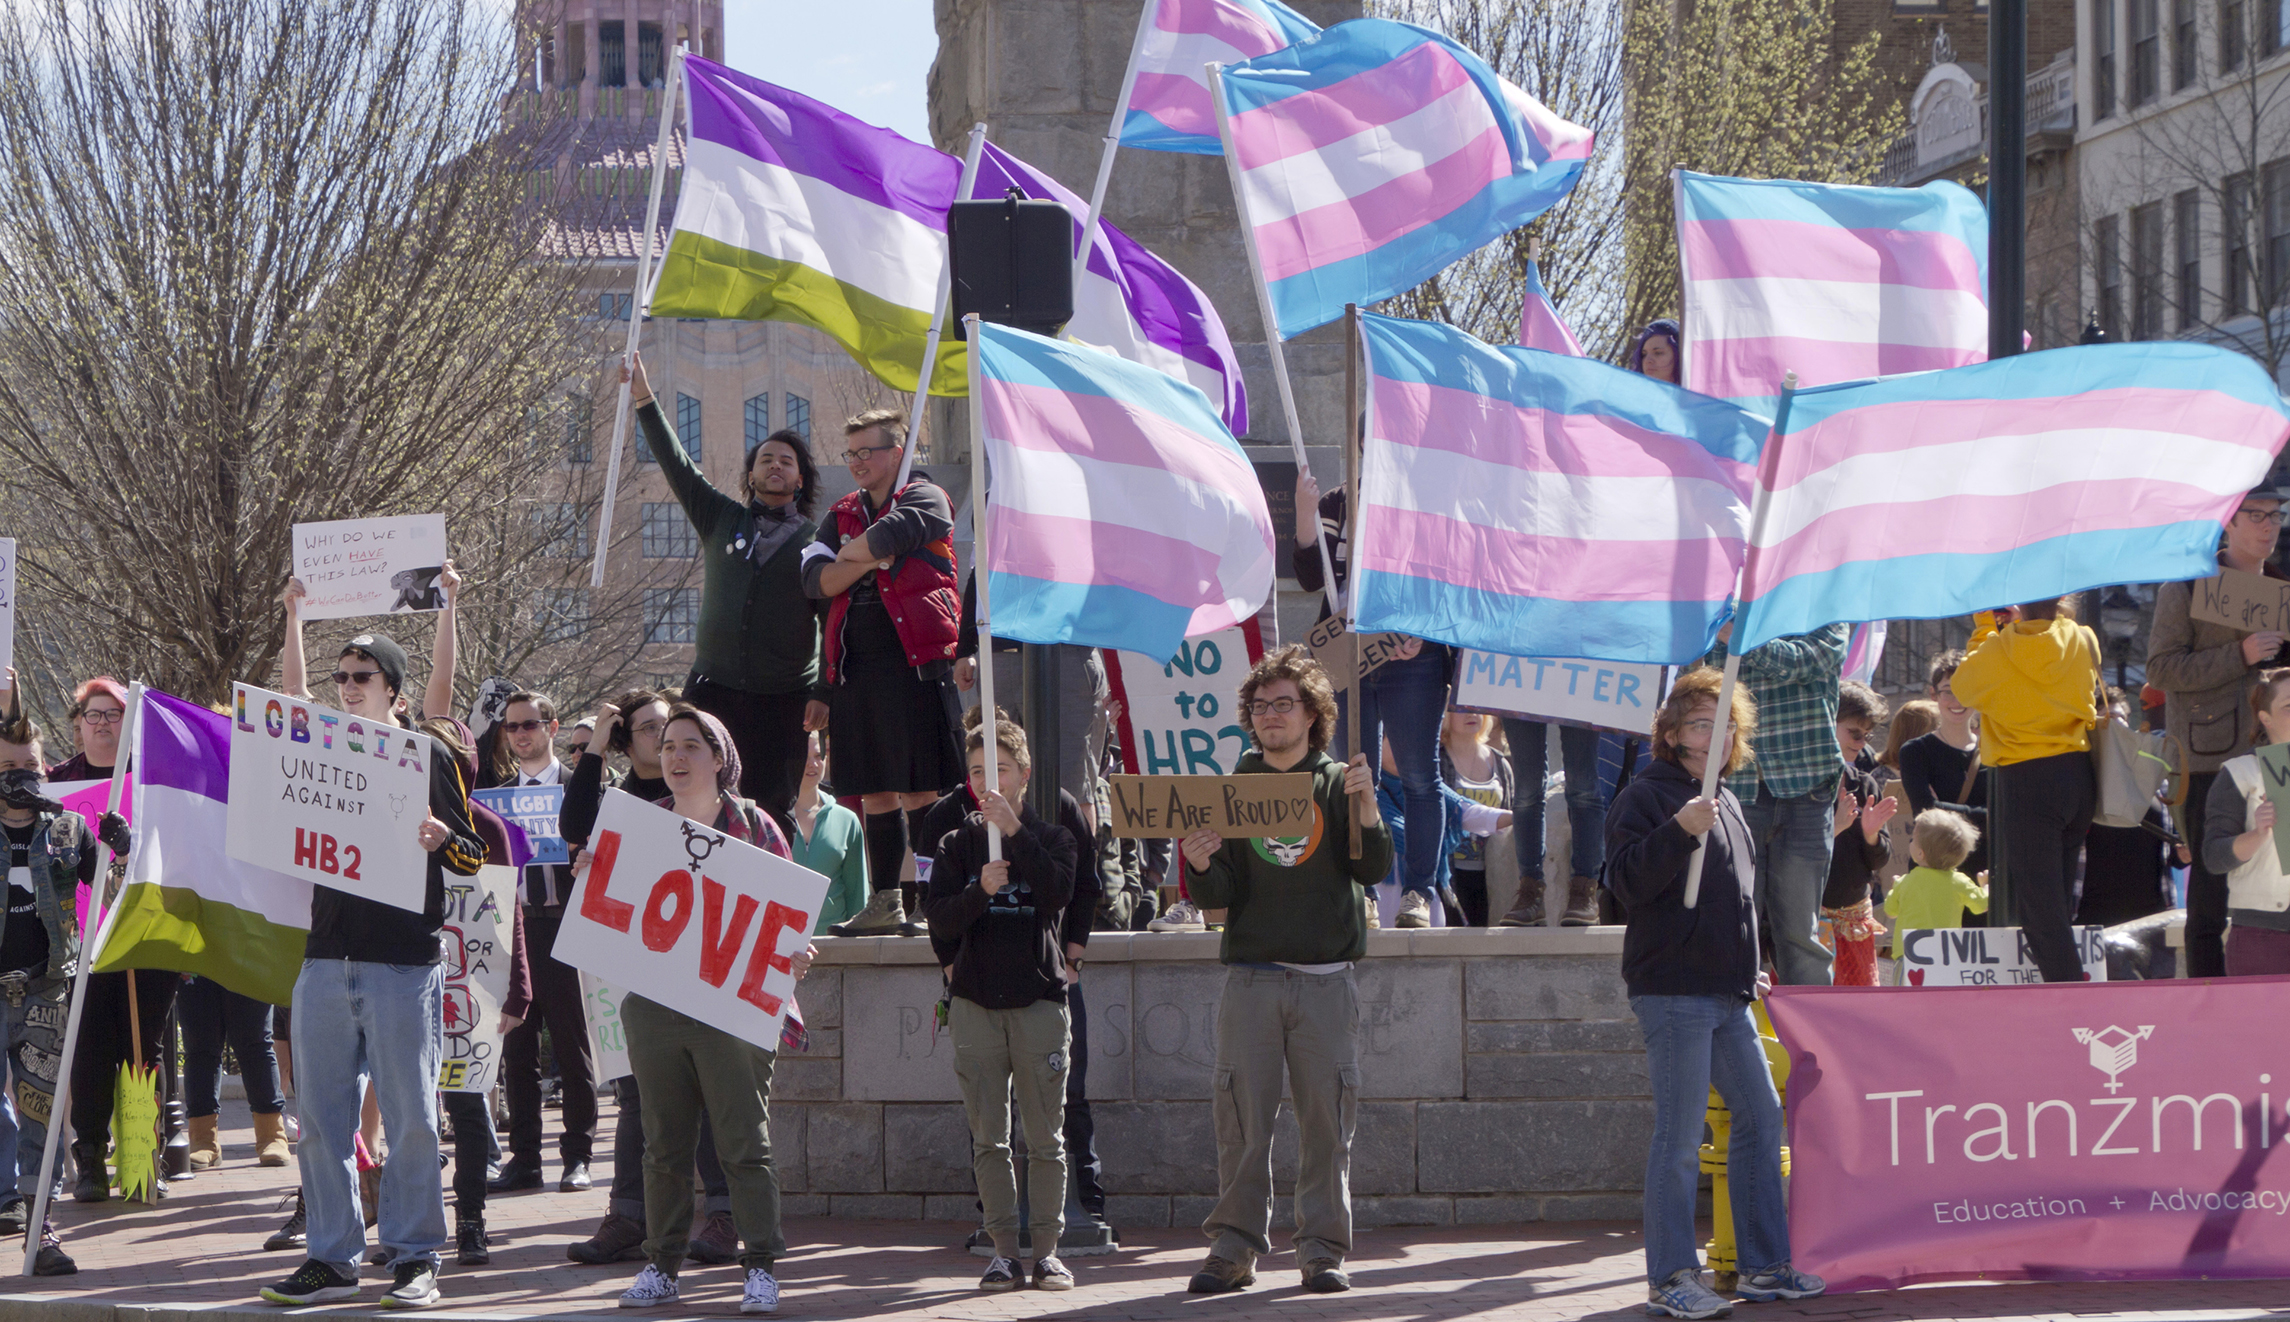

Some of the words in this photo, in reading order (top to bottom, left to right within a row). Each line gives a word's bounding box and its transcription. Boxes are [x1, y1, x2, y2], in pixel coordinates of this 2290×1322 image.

[305, 534, 334, 549] WHY
[343, 532, 363, 543] DO
[373, 530, 396, 541] WE
[303, 553, 342, 568] EVEN
[349, 548, 384, 561] HAVE
[306, 569, 344, 584] THIS
[351, 561, 387, 577] LAW?
[2204, 571, 2230, 618] We
[2242, 599, 2269, 628] are
[1164, 639, 1222, 678] NO
[1466, 652, 1642, 708] MATTER
[1174, 691, 1219, 719] to
[237, 689, 424, 773] LGBTQIA
[281, 755, 367, 791] UNITED
[282, 783, 365, 815] AGAINST
[511, 795, 554, 813] LGBT
[294, 827, 361, 881] HB2
[472, 890, 503, 924] A
[580, 828, 809, 1017] LOVE
[466, 938, 493, 956] OR
[1904, 929, 2000, 966] CIVIL
[470, 958, 490, 975] A
[1960, 969, 1998, 985] FOR
[450, 1035, 491, 1060] DO
[1933, 1195, 2086, 1223] Education
